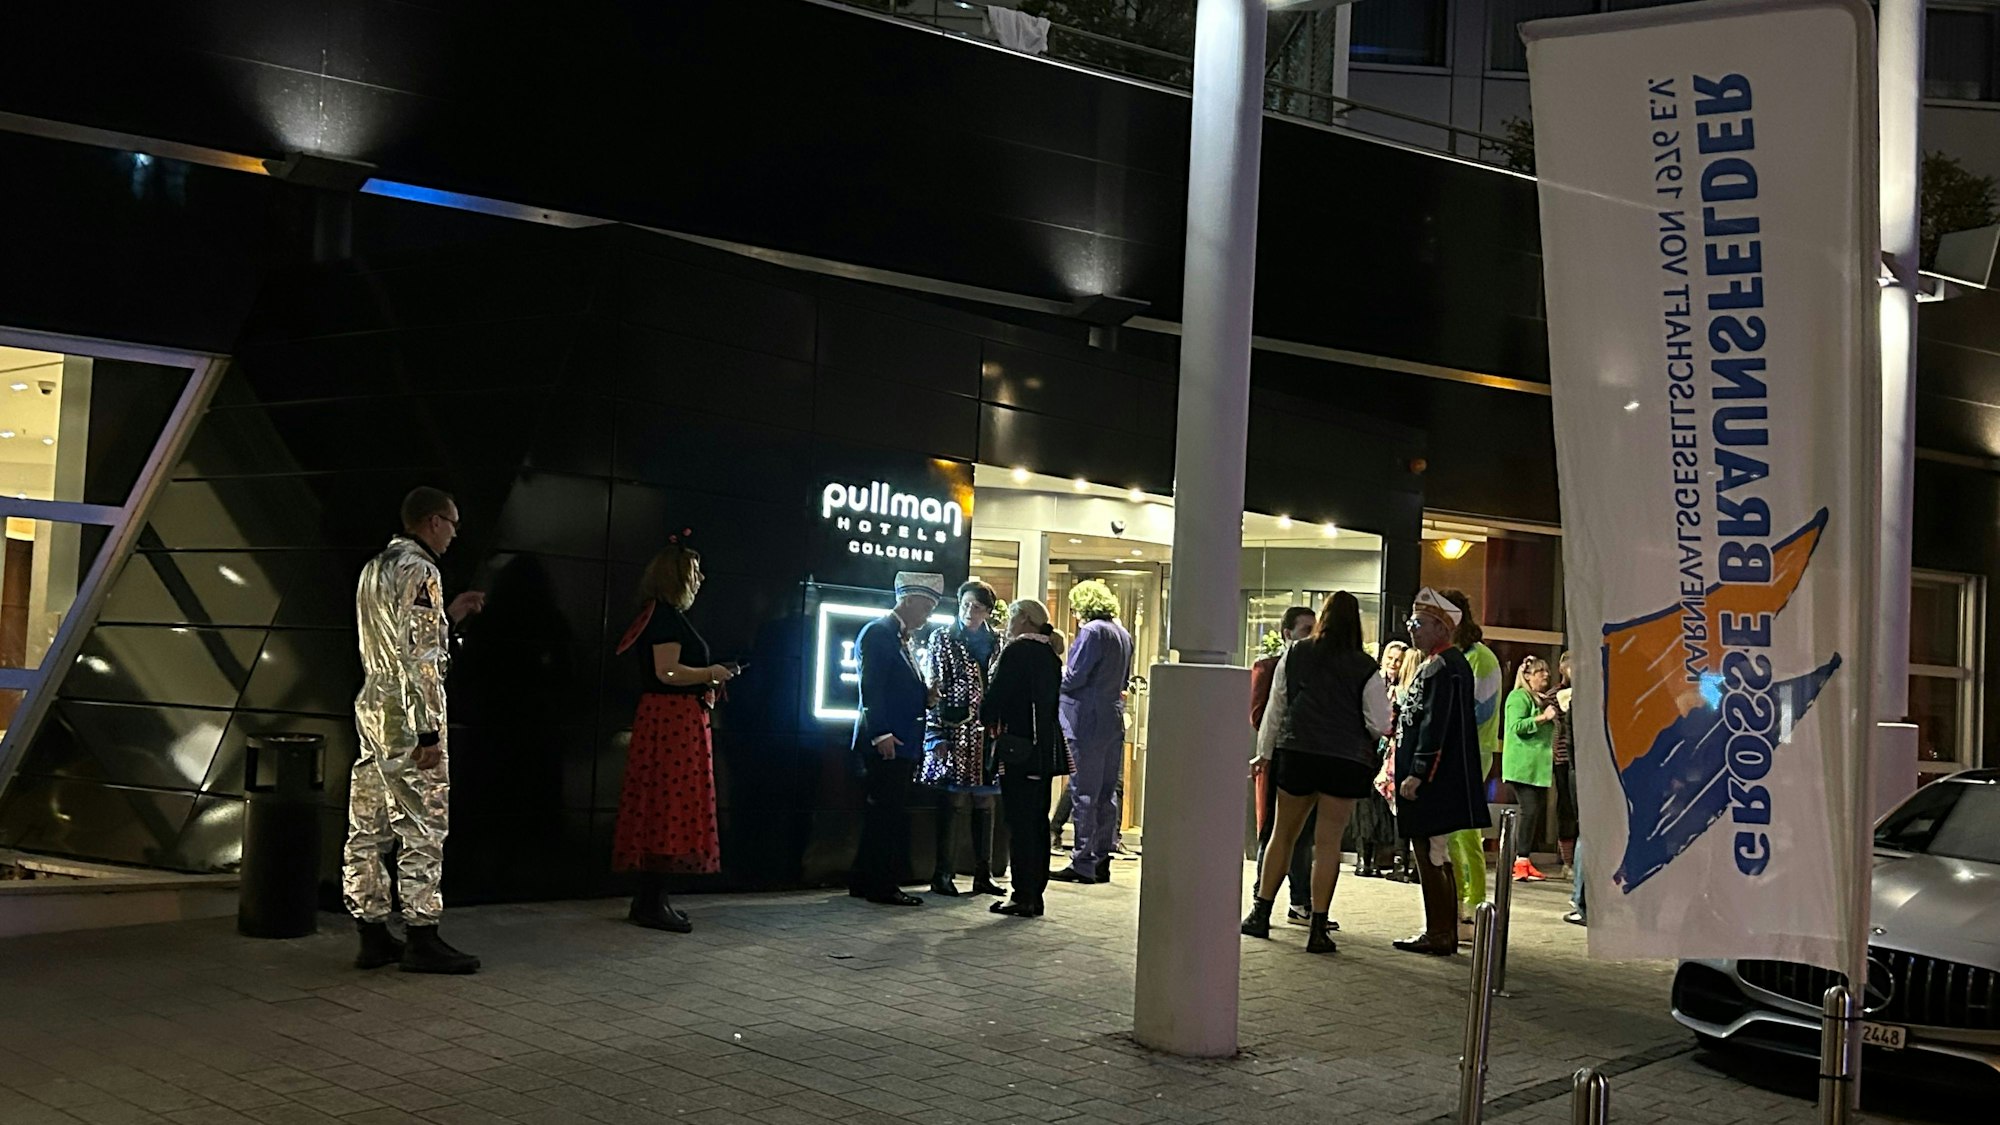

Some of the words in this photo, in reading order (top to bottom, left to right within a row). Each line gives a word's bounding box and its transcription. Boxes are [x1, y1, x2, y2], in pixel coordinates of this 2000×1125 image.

[822, 481, 962, 537] pullman
[837, 516, 947, 543] HOTELS
[849, 540, 934, 562] COLOGNE
[1862, 1025, 1900, 1046] 2448
